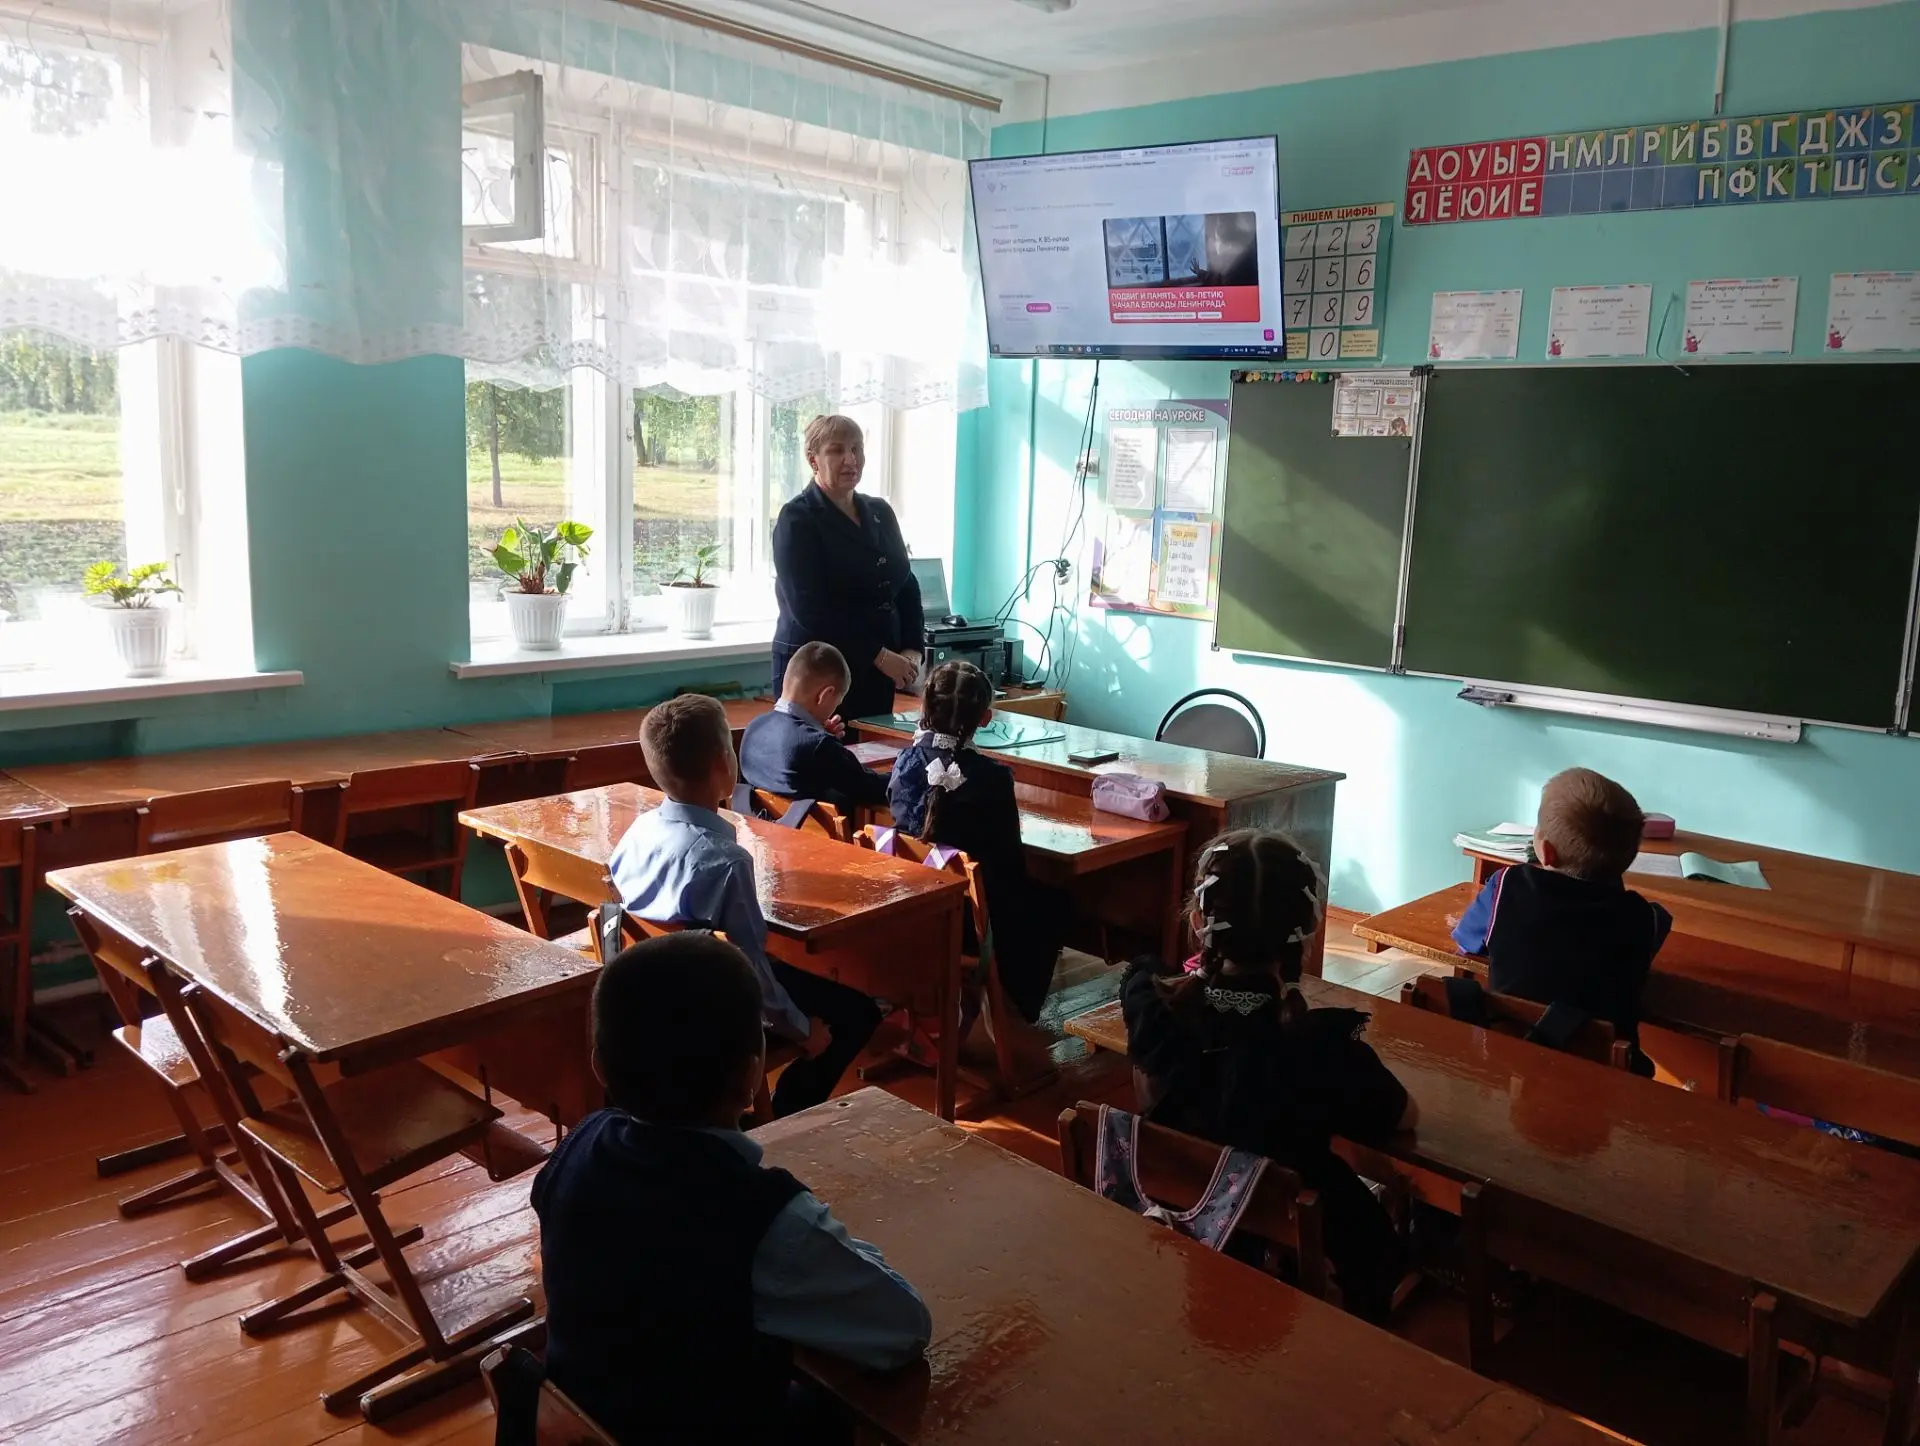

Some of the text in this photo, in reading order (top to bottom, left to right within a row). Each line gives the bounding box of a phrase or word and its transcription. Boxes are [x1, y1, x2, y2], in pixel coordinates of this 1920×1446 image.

[1411, 111, 1902, 183] А О У Ы Э Н М Л Р Й Б В Г Д Ж З
[1409, 191, 1427, 220] Я
[1437, 185, 1453, 218] Ё
[1460, 187, 1485, 217] Ю
[1489, 184, 1511, 215] И
[1519, 183, 1537, 213] Е
[1698, 169, 1719, 200] П
[1728, 166, 1756, 198] Ф
[1766, 164, 1789, 196] К
[1804, 162, 1825, 193] Т
[1834, 159, 1866, 192] Ш
[1875, 156, 1900, 189] С
[1292, 206, 1377, 223] ПИШЕМ ЦИФРЫ
[1300, 224, 1376, 253] 1 2 3
[1296, 259, 1372, 288] 4 5 6
[1111, 293, 1140, 301] ПОДВИГ
[1186, 291, 1224, 299] 85-ЛЕТИЮ
[1141, 300, 1176, 309] БЛОКАДЫ
[1177, 300, 1226, 308] ЛЕНИНГРАДА
[1293, 295, 1370, 324] 7 8 9
[1109, 410, 1206, 423] СЕГОДНЯ НА УРОКЕ
